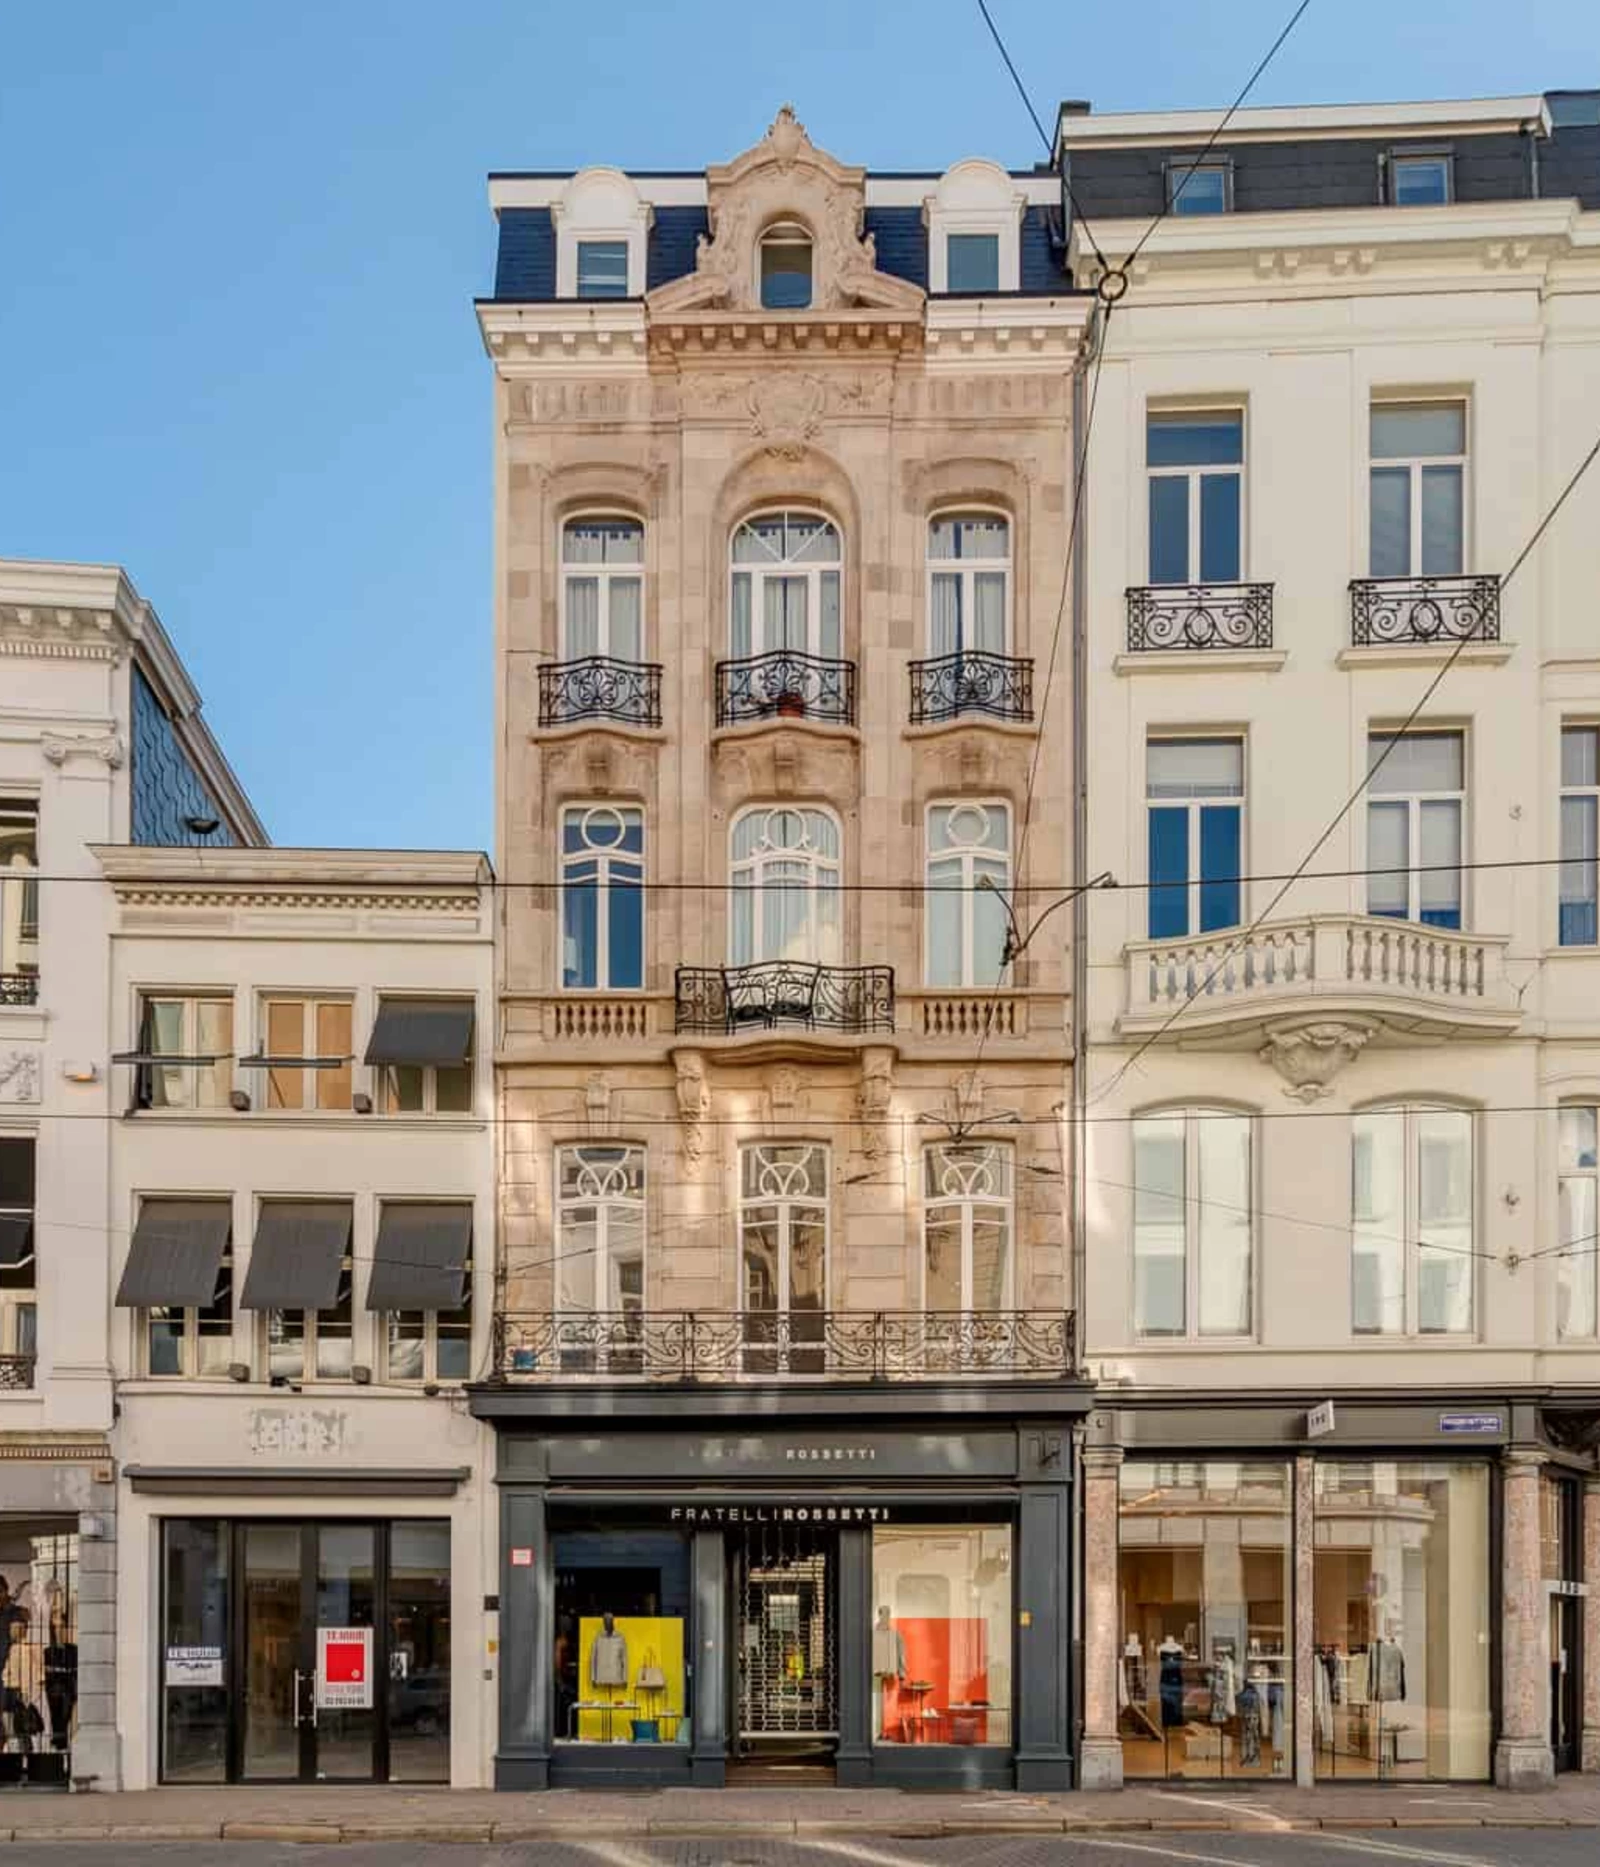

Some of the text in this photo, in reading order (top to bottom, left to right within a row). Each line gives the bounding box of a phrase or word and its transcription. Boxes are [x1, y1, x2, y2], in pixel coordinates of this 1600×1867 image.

[786, 1449, 876, 1460] ROSSETTI
[671, 1508, 890, 1521] FRATELLI ROSSETTI
